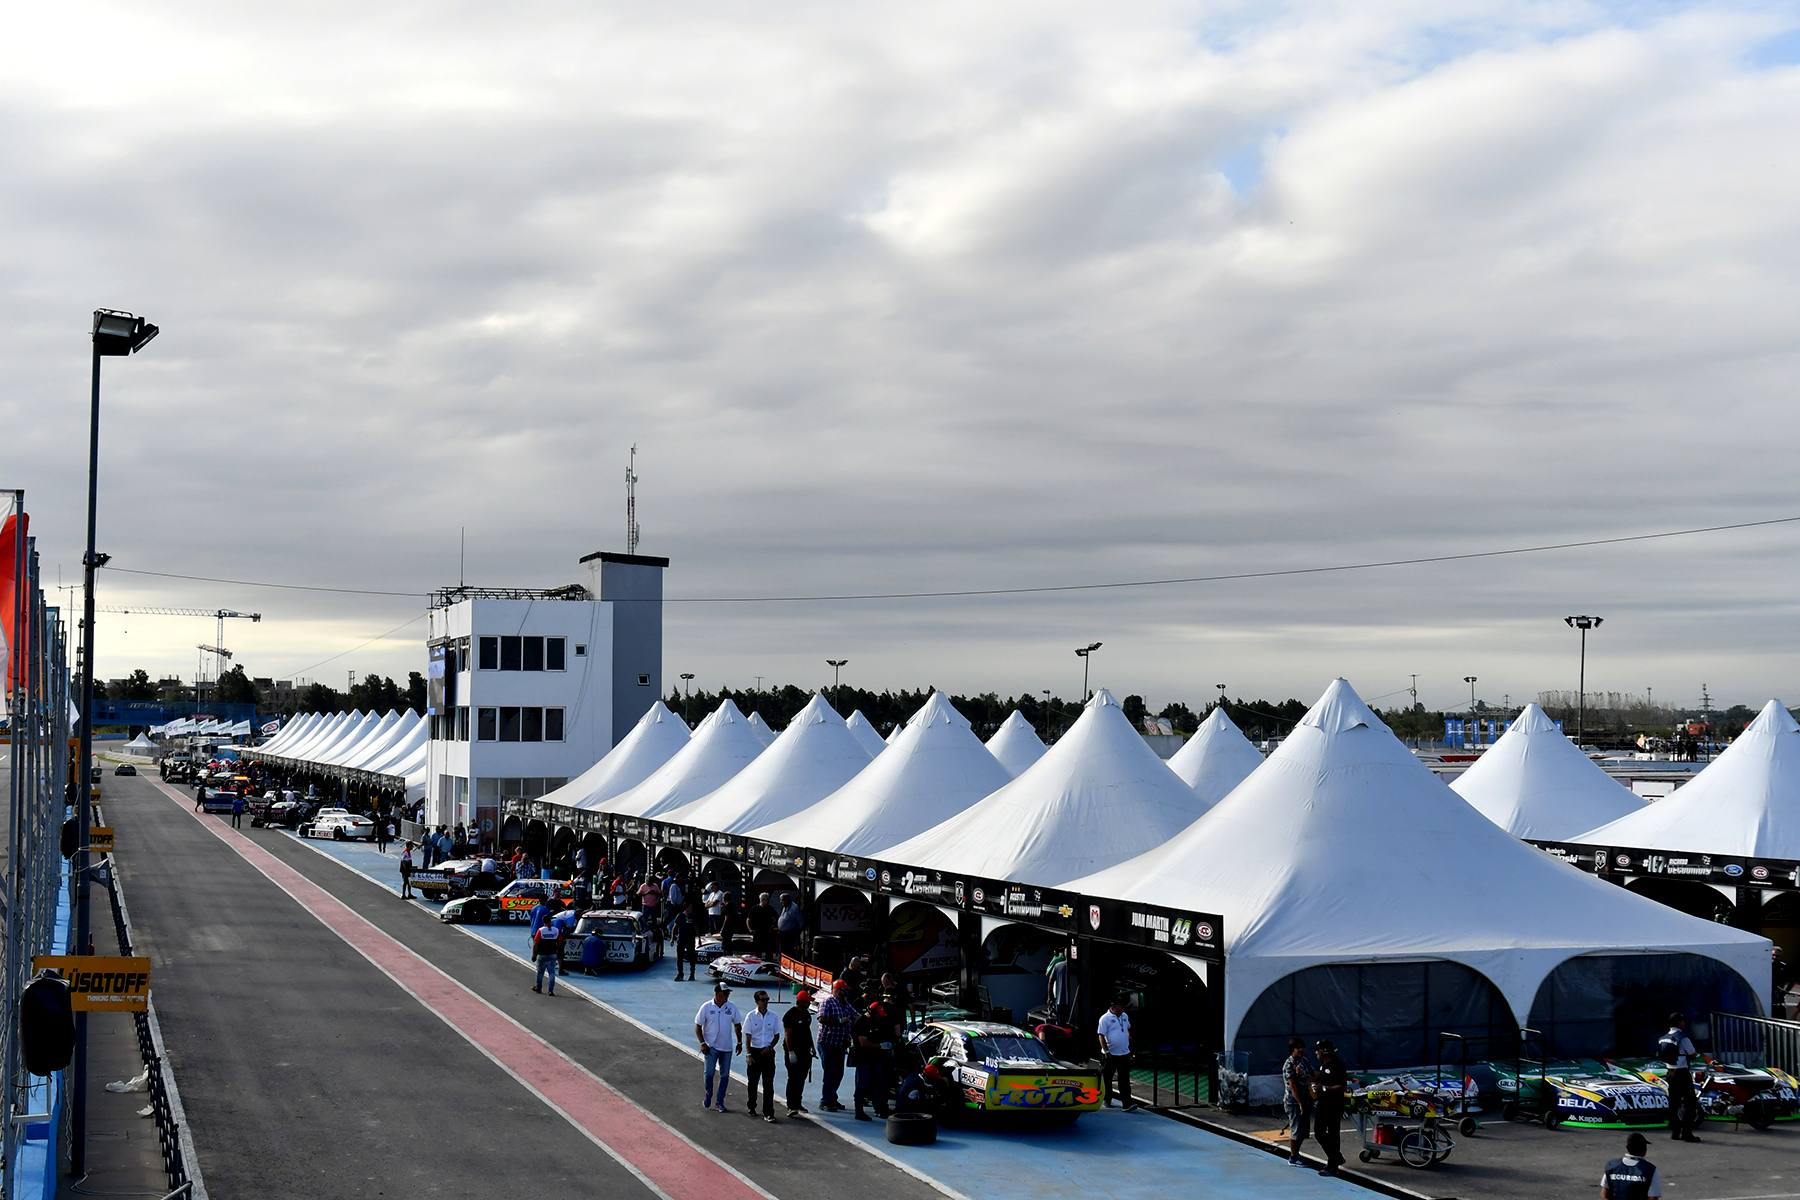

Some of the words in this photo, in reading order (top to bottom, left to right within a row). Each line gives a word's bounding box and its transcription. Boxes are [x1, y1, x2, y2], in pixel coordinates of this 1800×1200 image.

[508, 911, 530, 920] BRA
[991, 1087, 1074, 1106] FRUTA
[1075, 1087, 1101, 1104] 3
